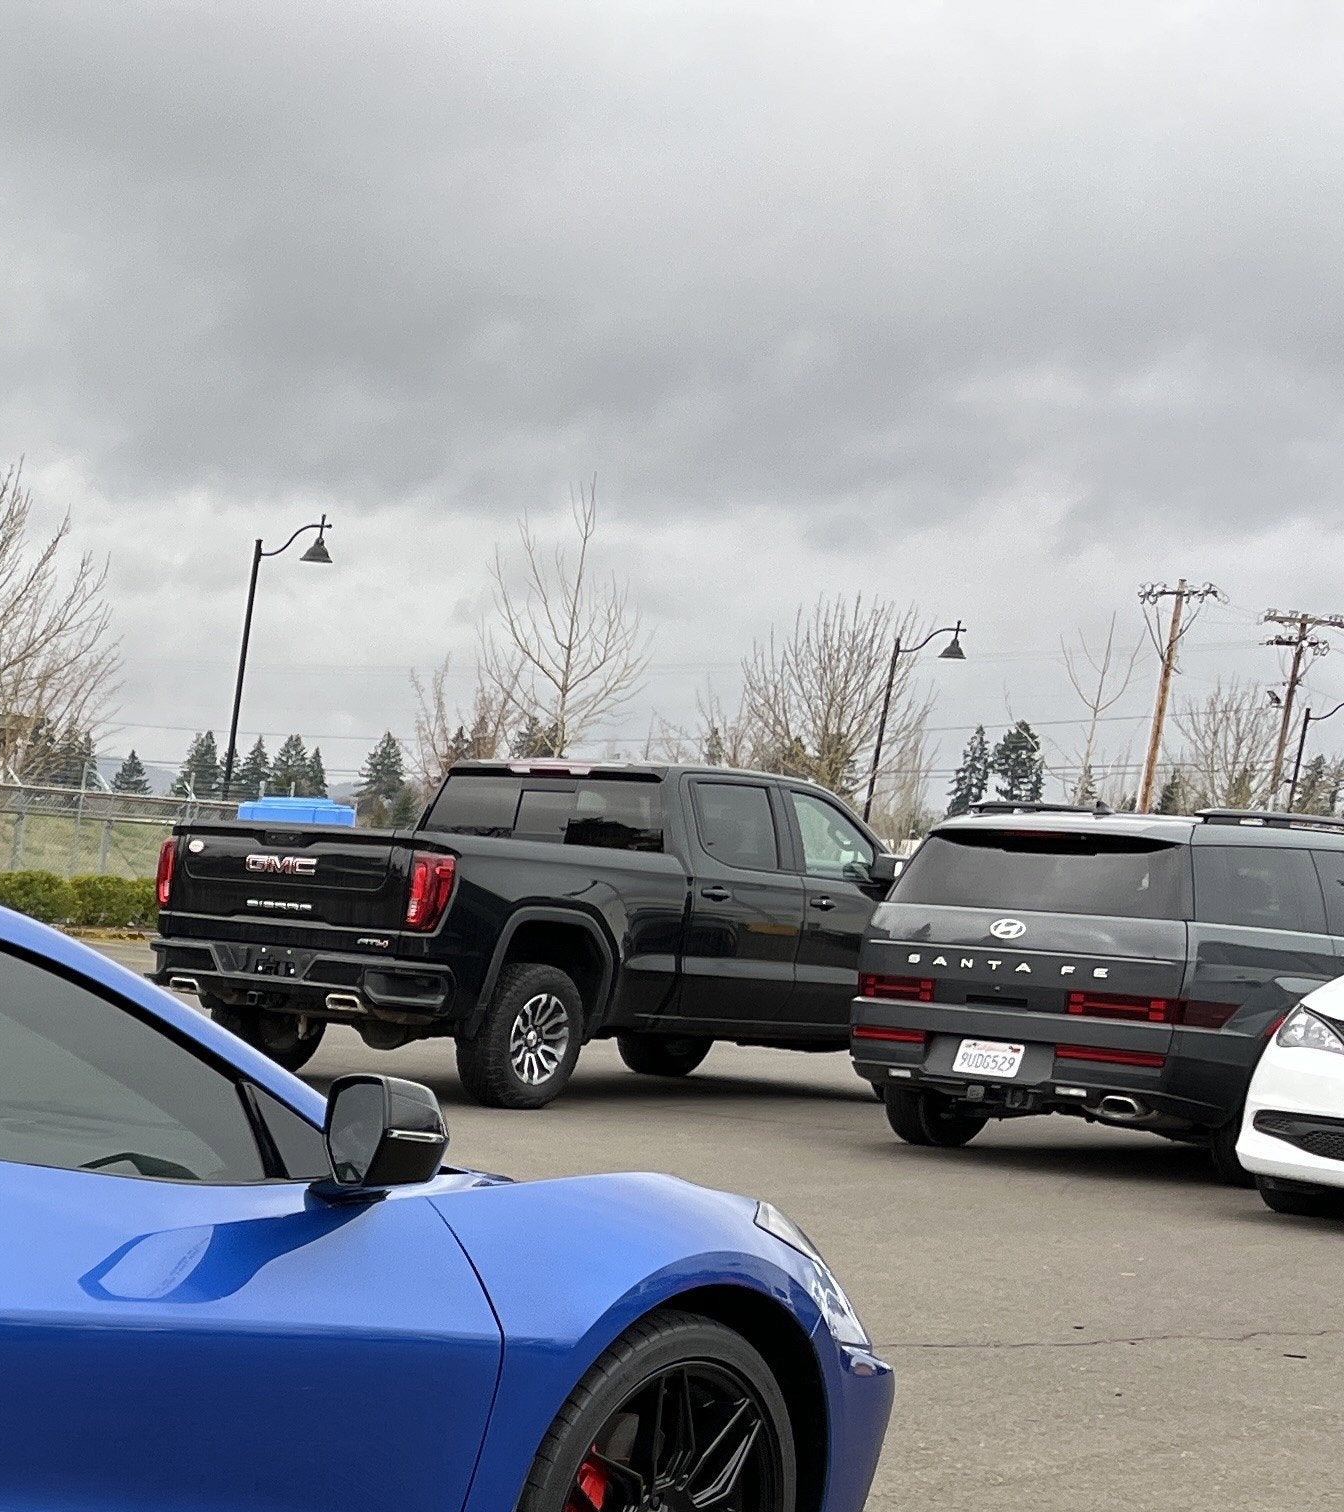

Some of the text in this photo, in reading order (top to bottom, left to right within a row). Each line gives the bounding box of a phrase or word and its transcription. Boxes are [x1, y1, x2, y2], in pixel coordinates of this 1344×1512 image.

[246, 854, 318, 876] GMC
[907, 953, 1109, 979] SANTA FE
